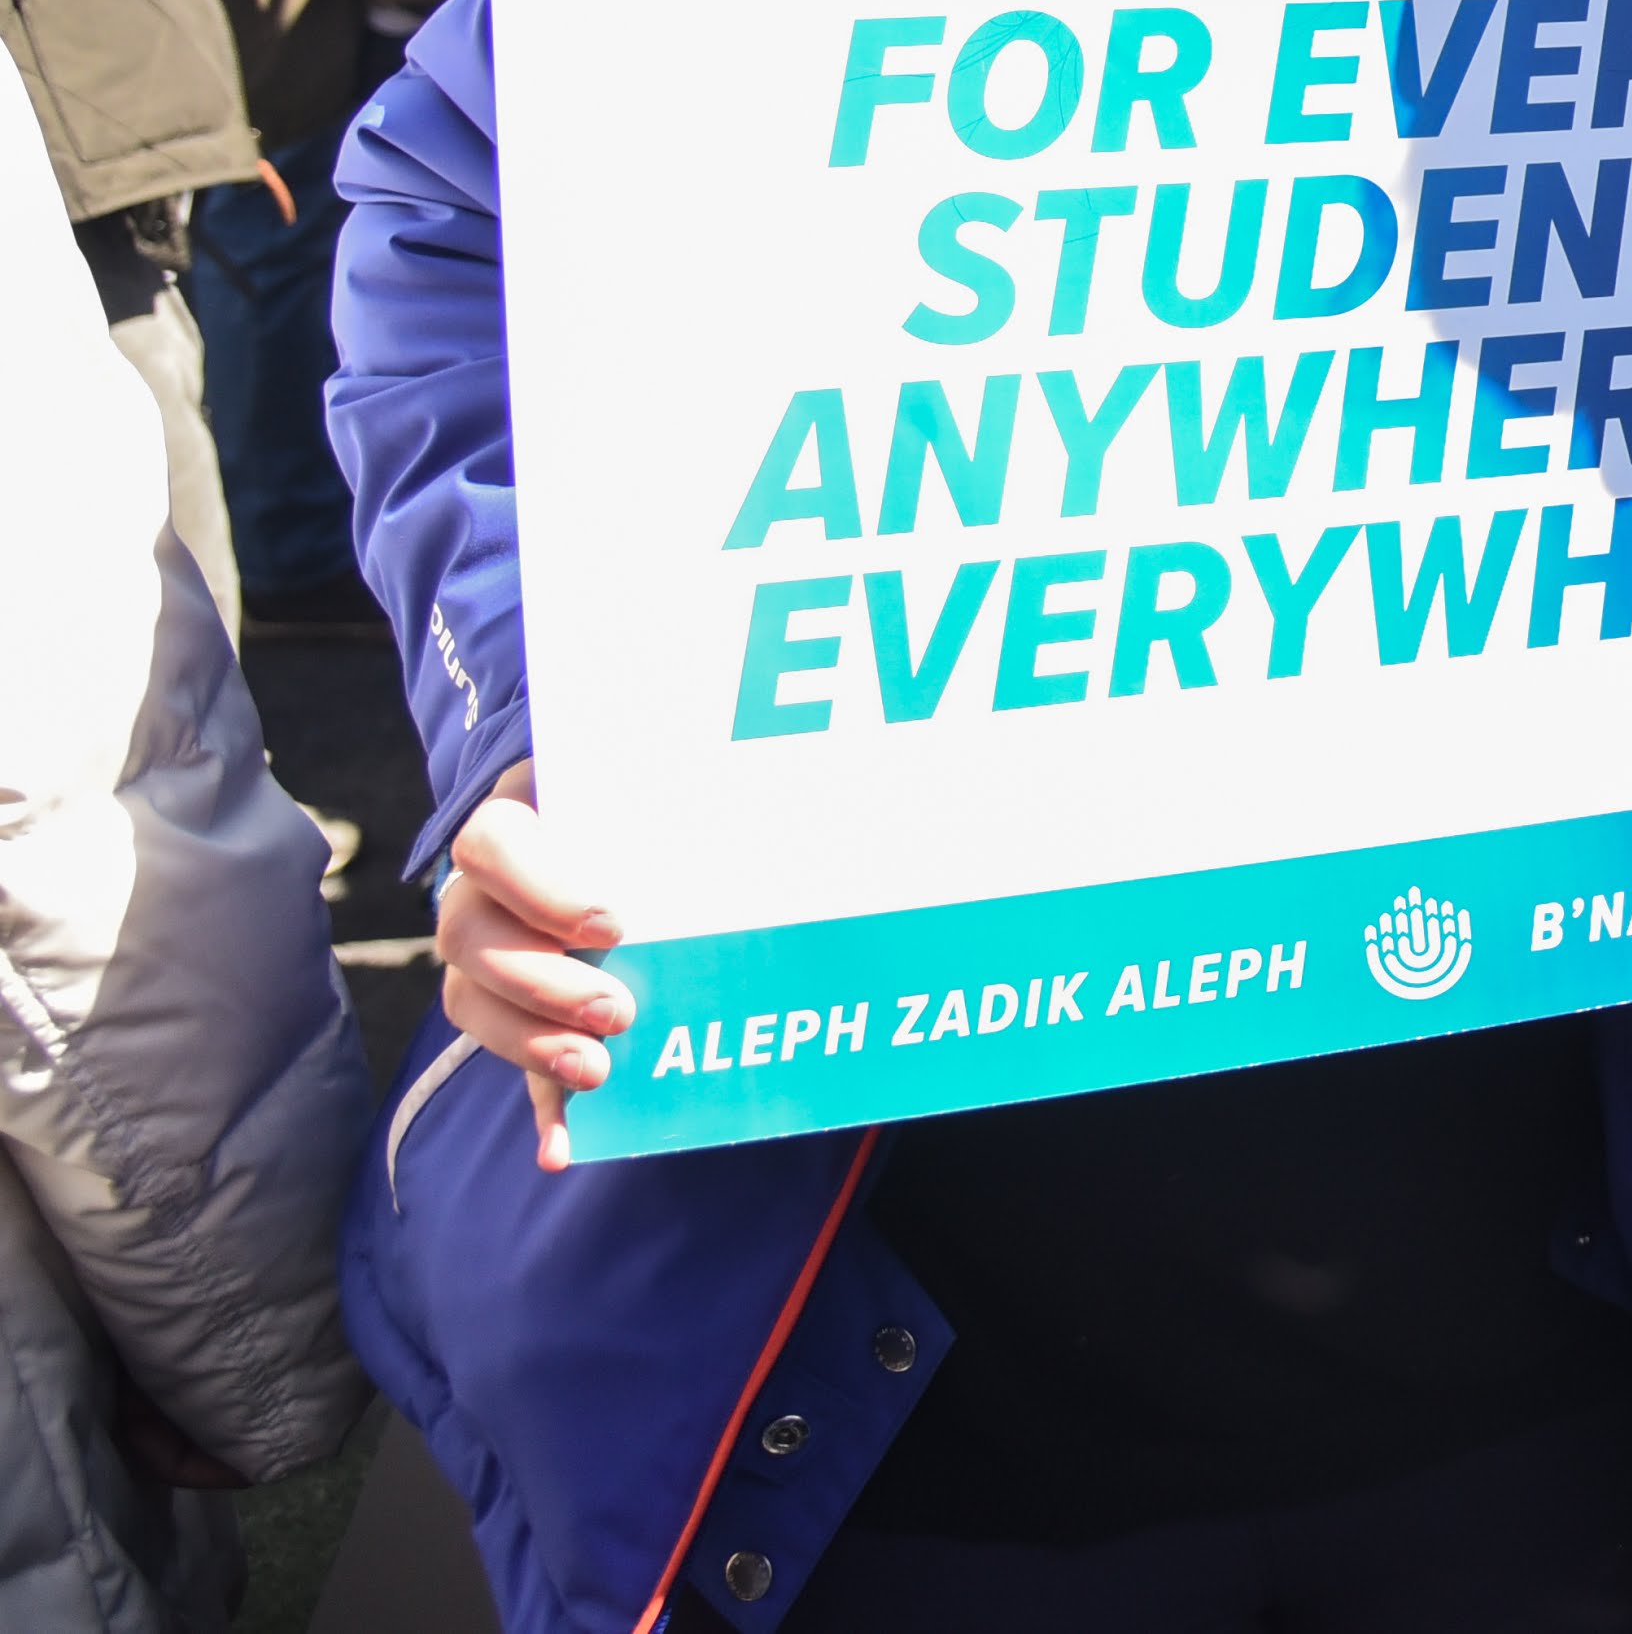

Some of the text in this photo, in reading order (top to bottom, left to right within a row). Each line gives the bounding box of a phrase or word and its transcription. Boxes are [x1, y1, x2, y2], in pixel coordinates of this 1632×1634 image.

[828, 7, 1213, 167] FOR
[652, 941, 1308, 1078] ALEPH ZADIK ALEPH
